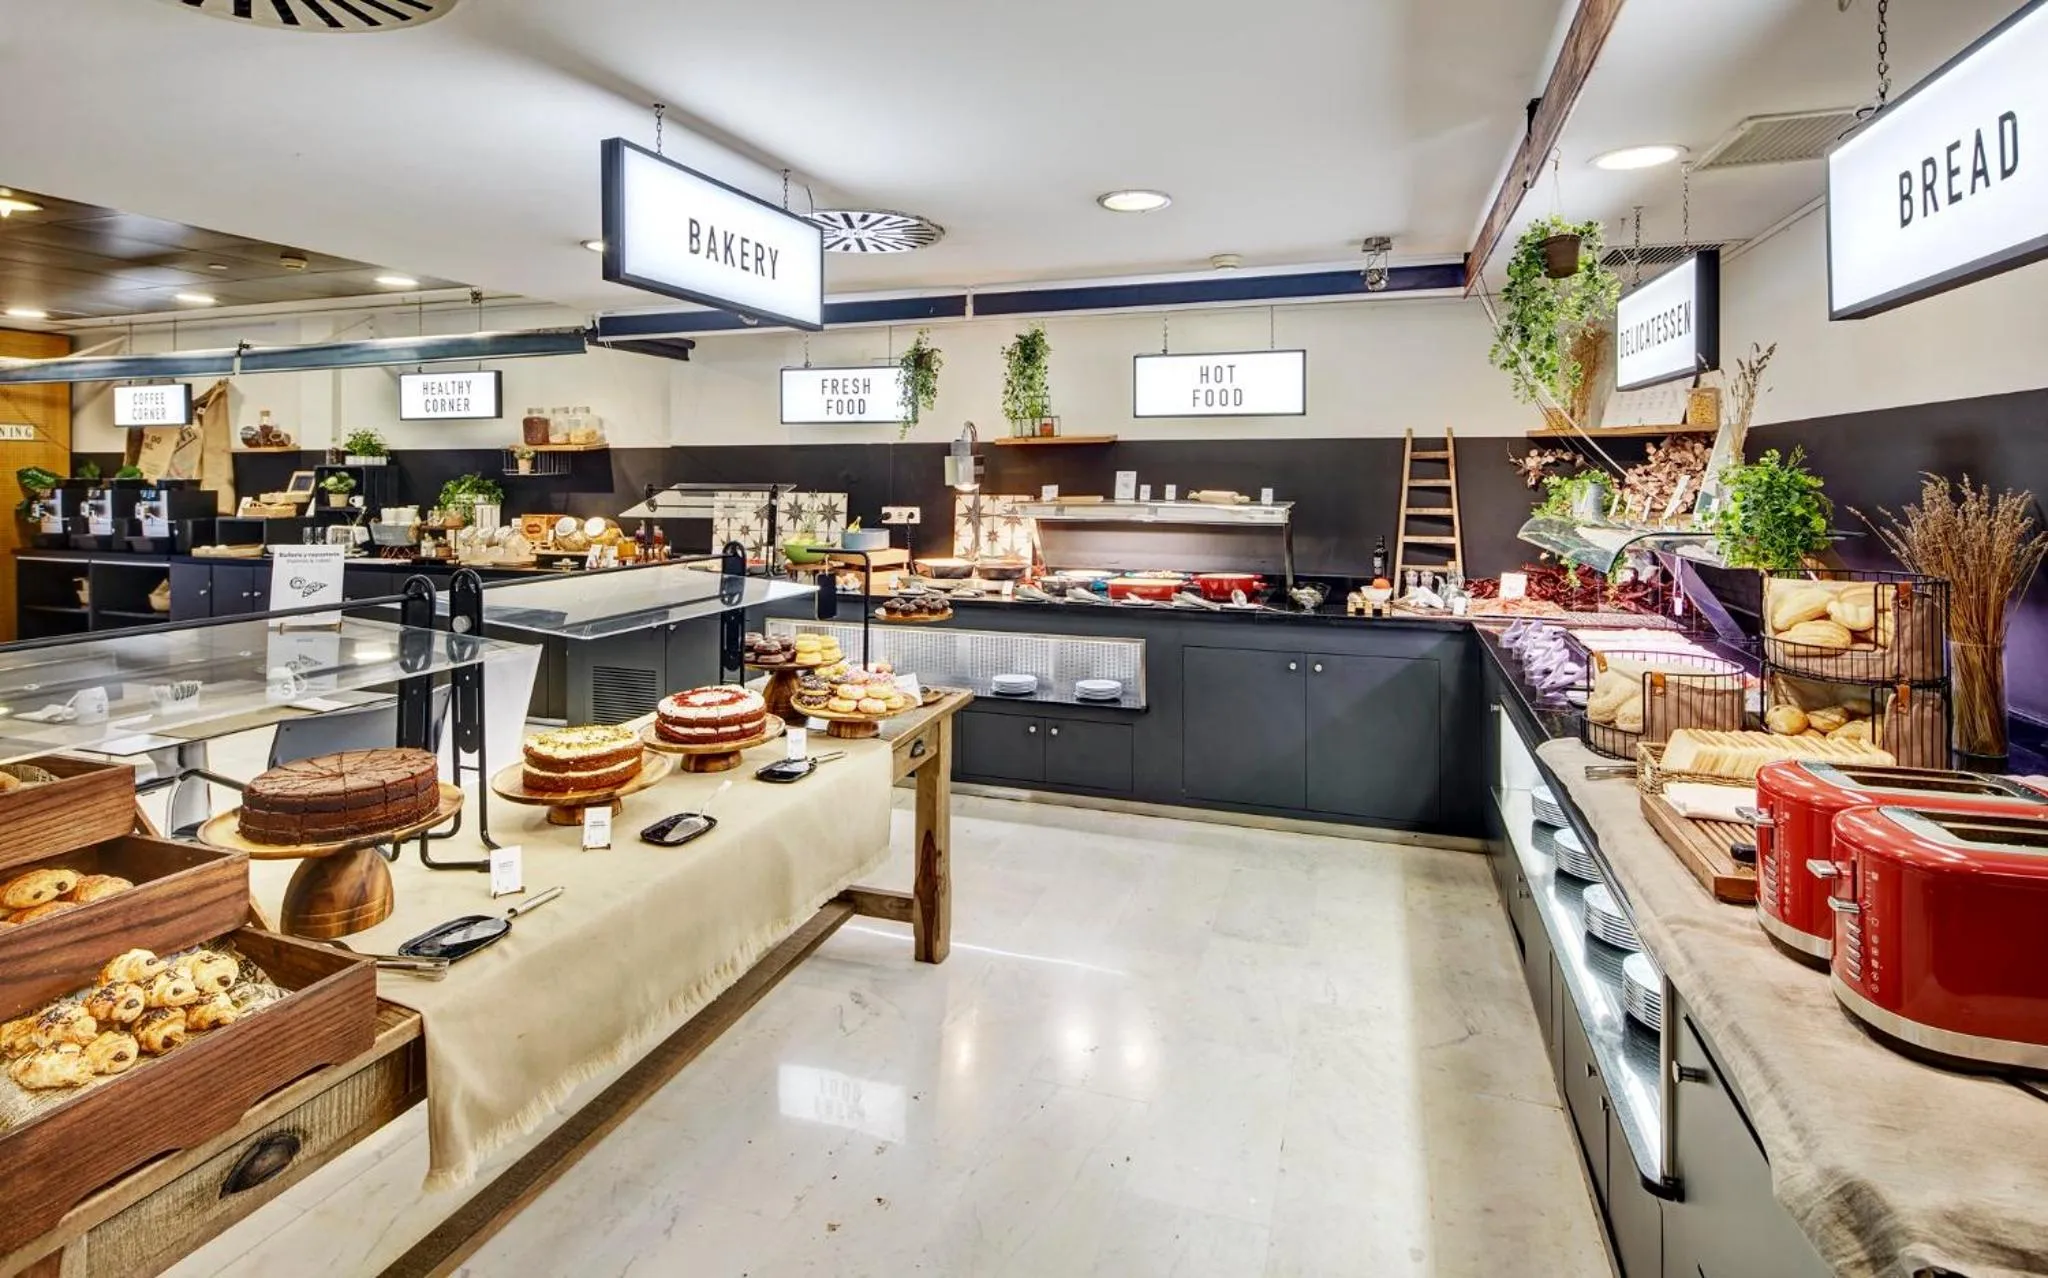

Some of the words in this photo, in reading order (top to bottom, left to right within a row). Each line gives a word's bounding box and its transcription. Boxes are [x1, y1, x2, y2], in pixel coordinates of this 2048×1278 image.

[1899, 110, 2019, 229] BREAD
[688, 217, 779, 281] BAKERY
[1620, 299, 1692, 359] DELICATESSEN
[1199, 365, 1236, 384] HOT
[422, 380, 472, 396] HEALTHY
[821, 378, 871, 395] FRESH
[132, 392, 165, 405] COFFEE
[424, 397, 471, 413] CORNER
[826, 398, 866, 416] FOOD
[1192, 388, 1243, 408] FOOD
[132, 407, 166, 421] CORNER
